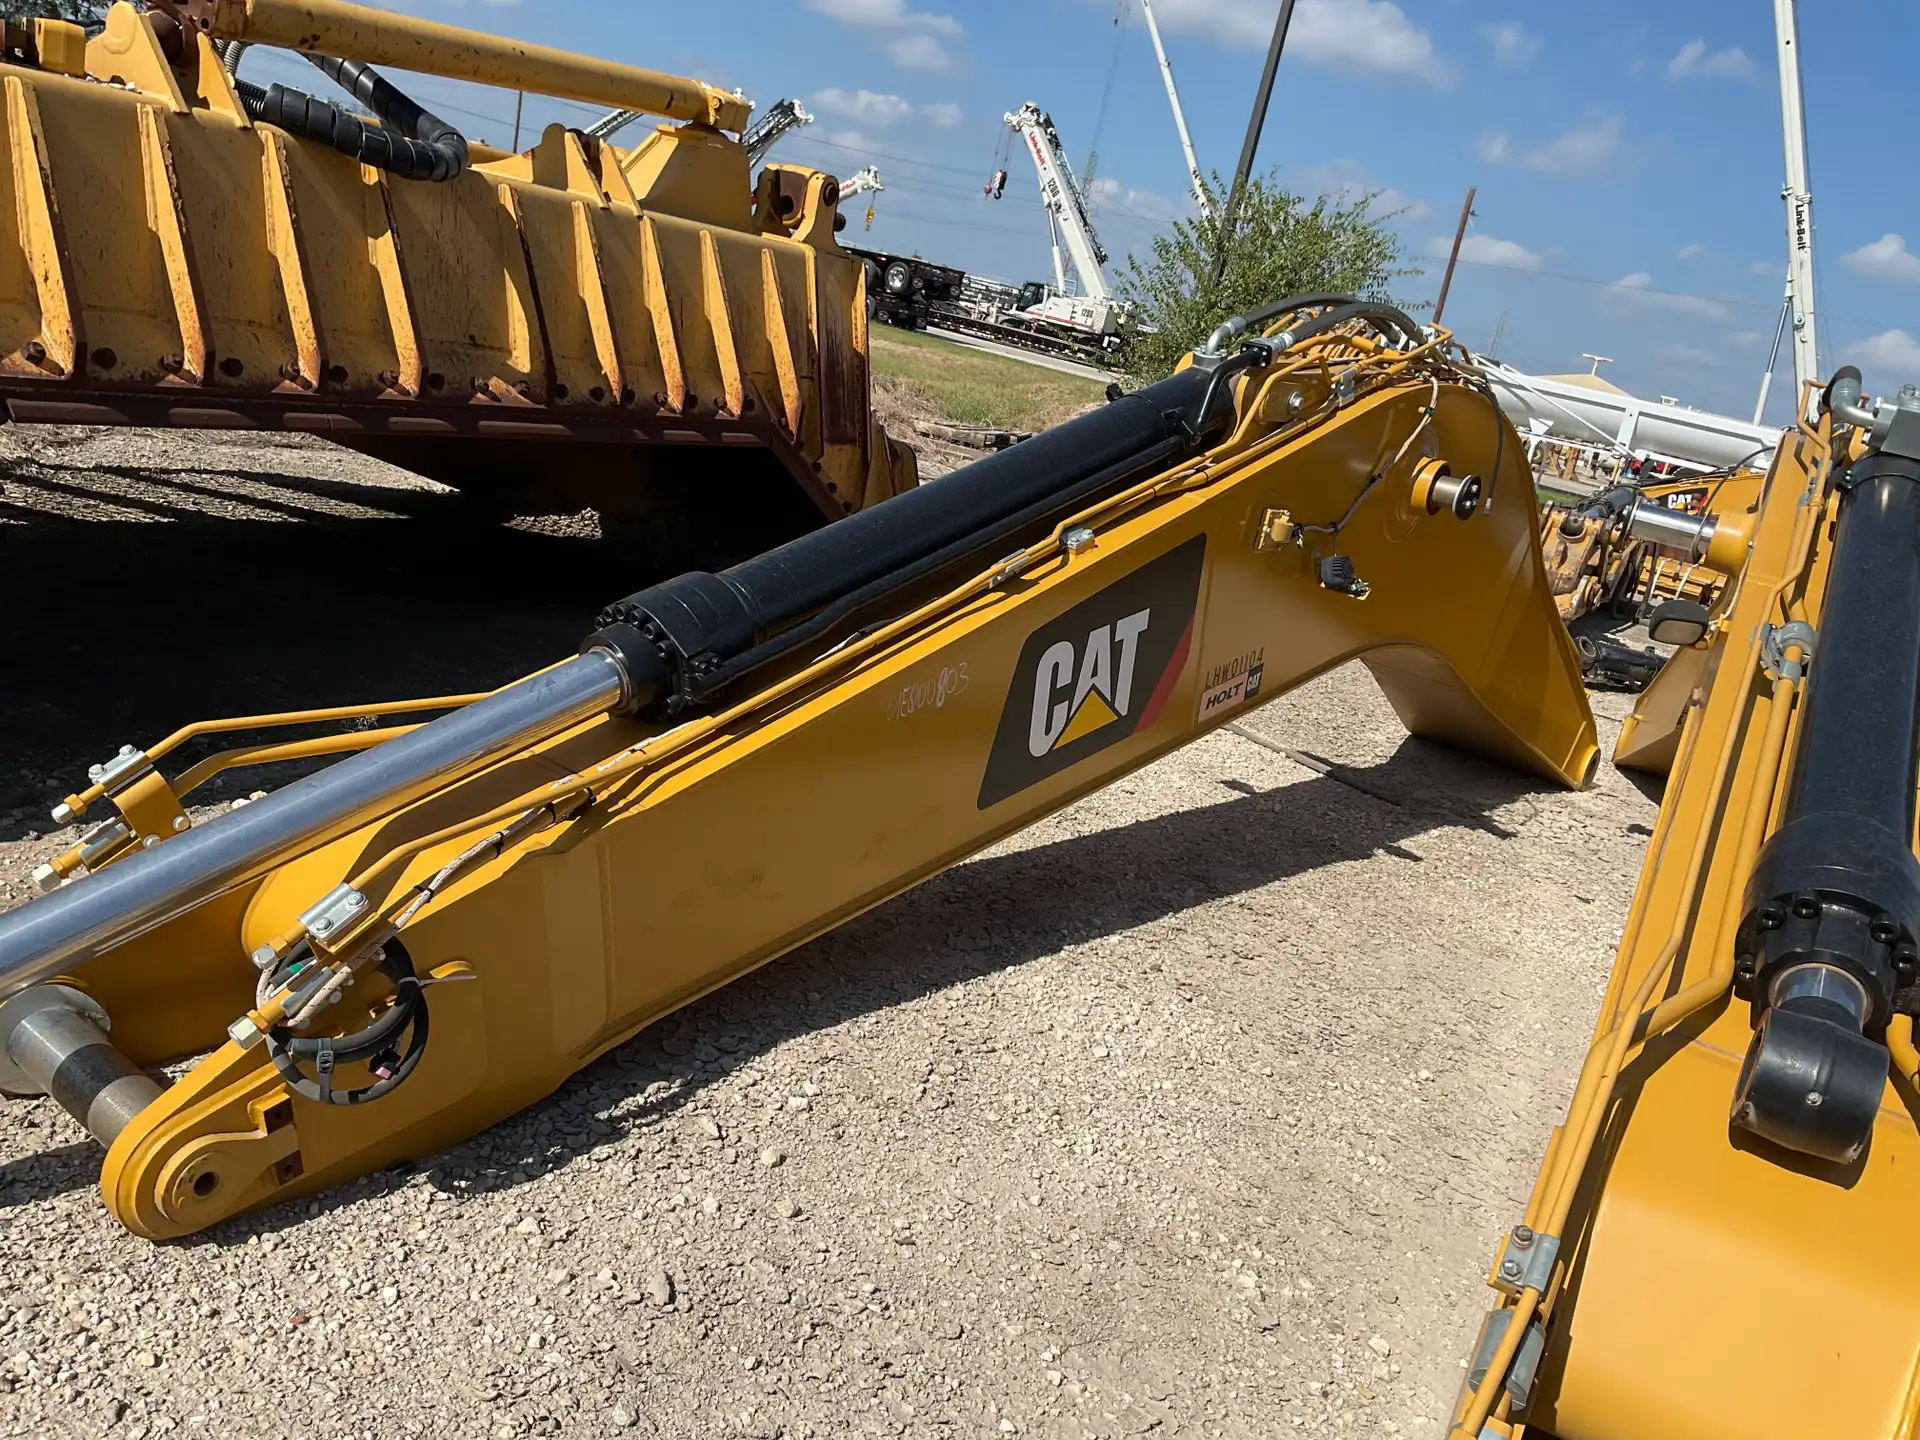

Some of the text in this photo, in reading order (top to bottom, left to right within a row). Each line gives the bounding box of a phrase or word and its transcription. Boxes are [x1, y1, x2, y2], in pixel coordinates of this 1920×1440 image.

[1047, 178, 1060, 198] 1200
[1667, 494, 1692, 509] CAT
[1029, 608, 1150, 757] CAT
[1205, 672, 1262, 710] HOLT CAT
